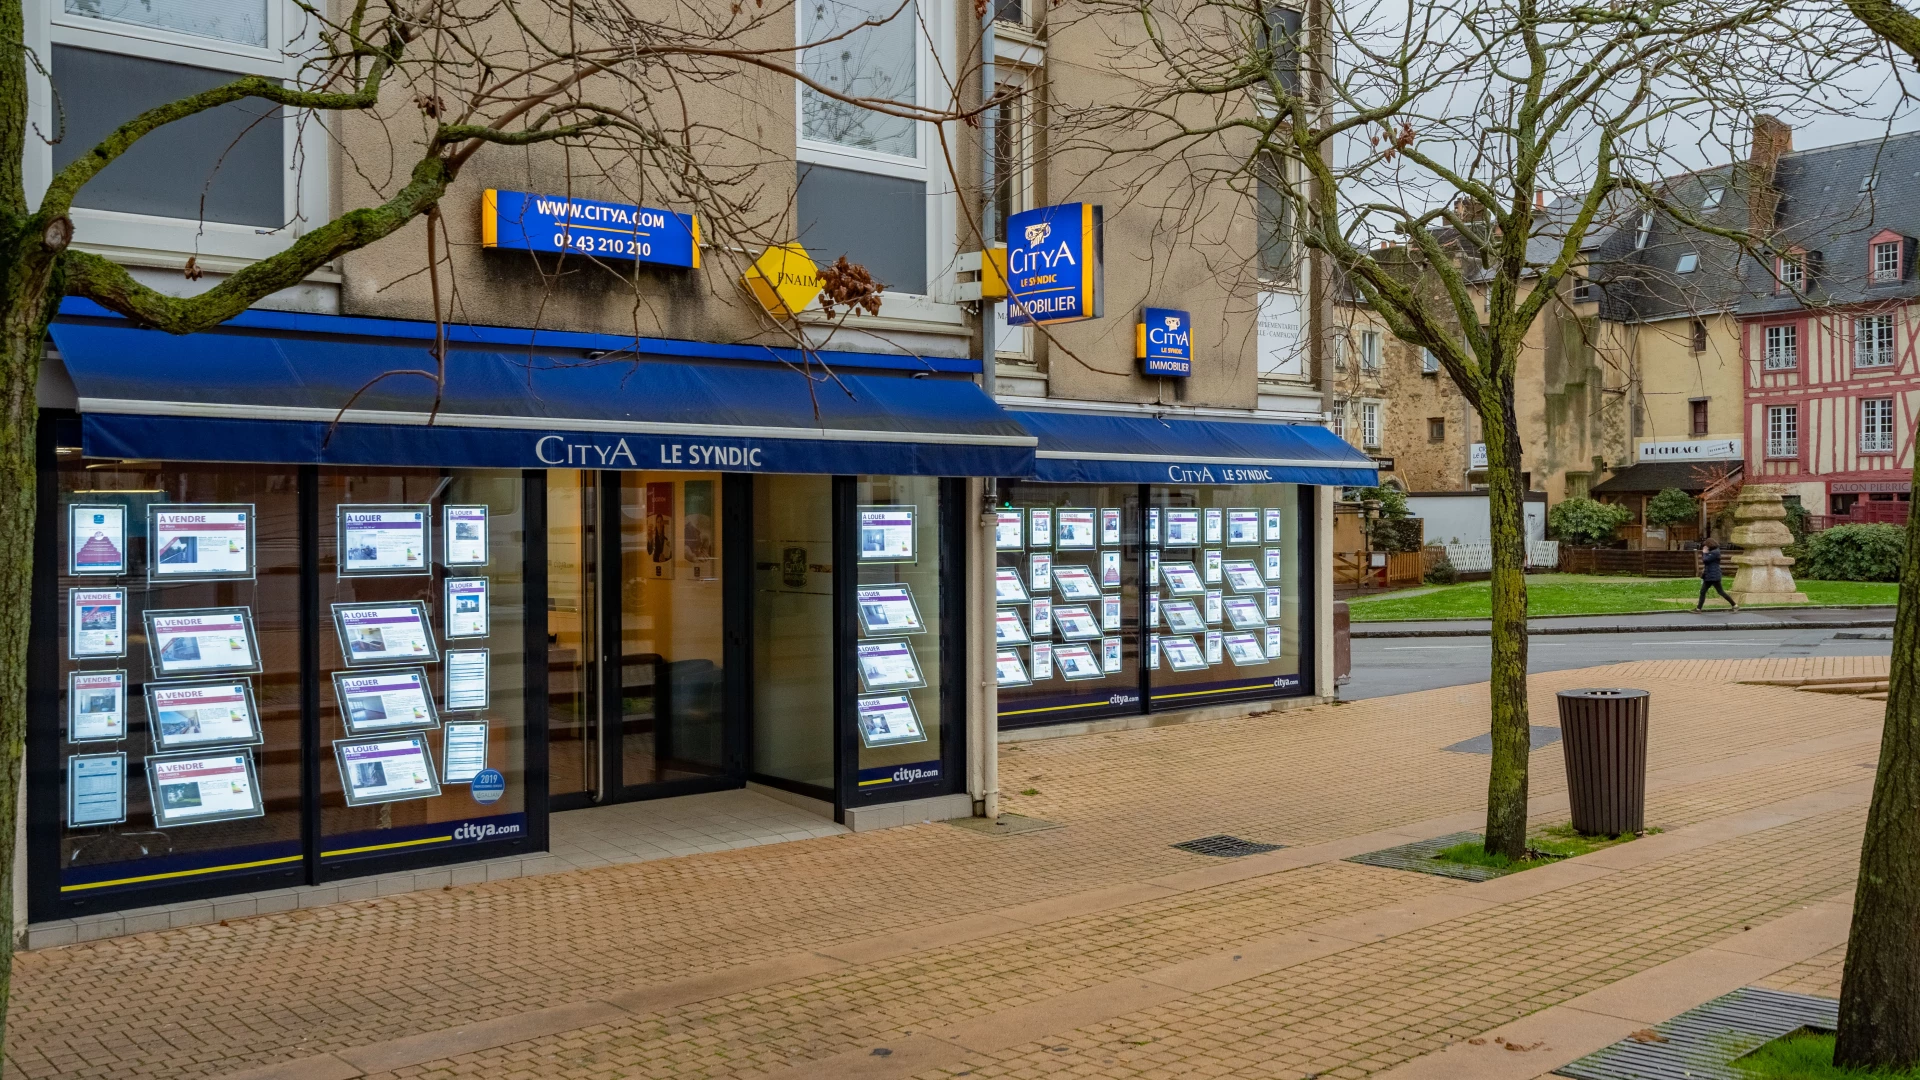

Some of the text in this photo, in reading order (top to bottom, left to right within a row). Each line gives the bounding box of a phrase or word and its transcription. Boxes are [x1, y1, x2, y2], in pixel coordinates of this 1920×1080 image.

[537, 200, 664, 228] WWW.CITYA.COM
[554, 234, 651, 256] 02 43 210 210
[778, 272, 818, 287] FNAIM
[1021, 274, 1057, 287] LE SYNDIC
[1150, 361, 1189, 372] IMMOBILIER
[661, 444, 682, 464] LE
[689, 445, 761, 466] SYNDIC
[1659, 446, 1701, 454] CHICAGO
[1223, 469, 1234, 480] LE
[1236, 469, 1272, 481] SYNDIC
[1832, 483, 1909, 492] SALON PIERRIC
[165, 618, 202, 626] VENDRE
[1273, 677, 1299, 688] citya.com
[1110, 694, 1139, 705] citya.com
[166, 762, 204, 772] VENDRE
[481, 774, 498, 784] 2019
[893, 767, 939, 781] citya.com
[454, 823, 520, 841] citya.com
